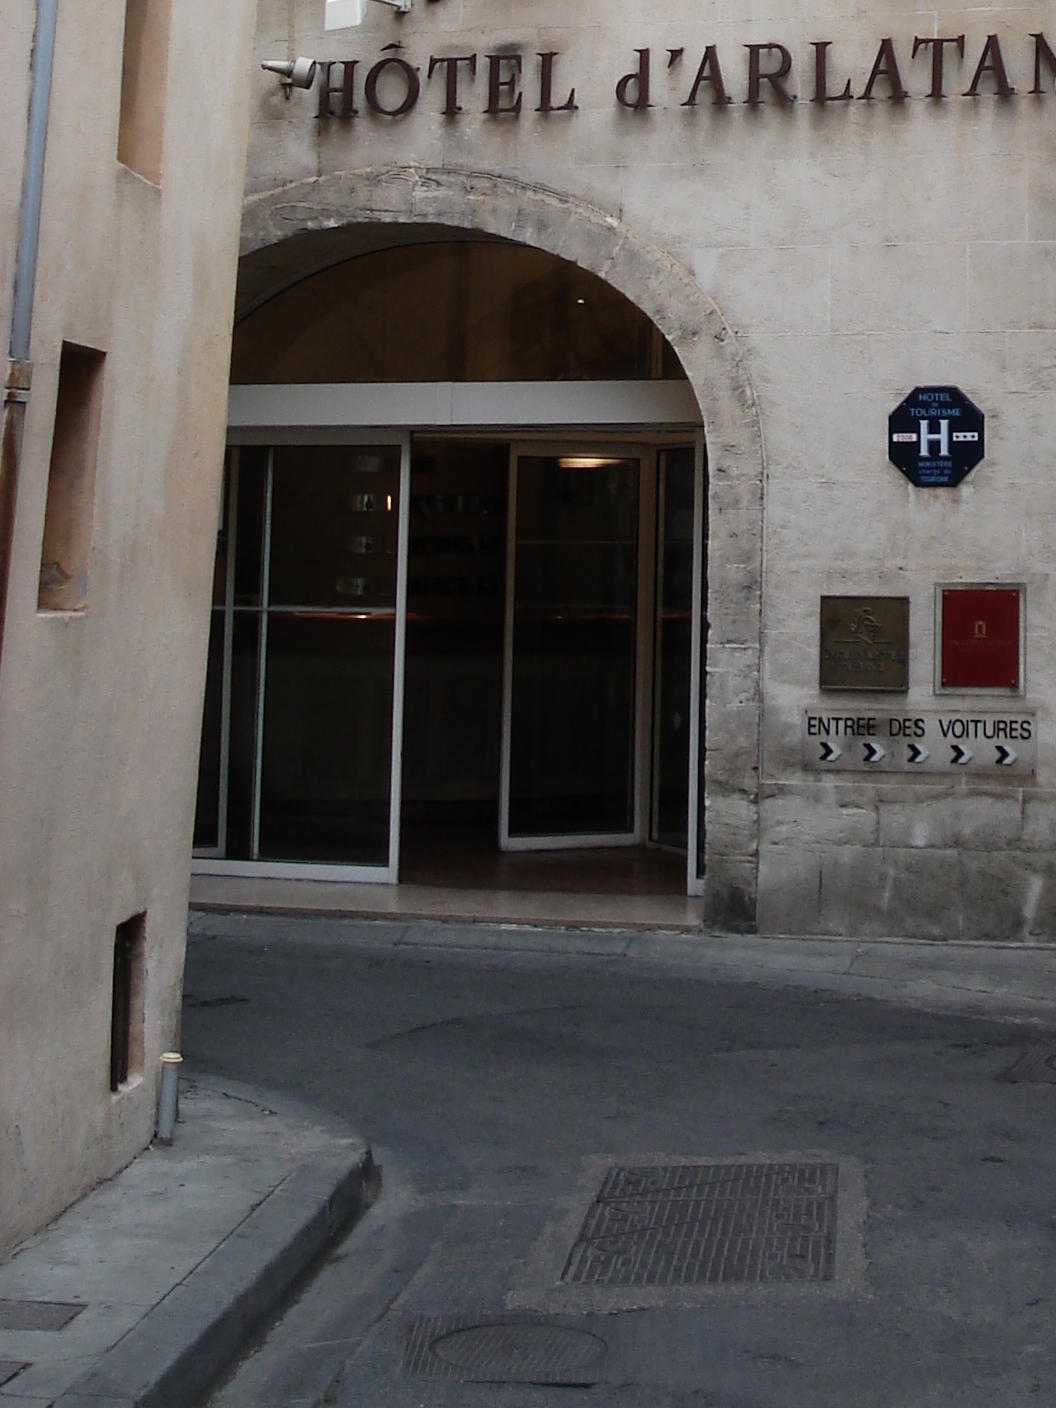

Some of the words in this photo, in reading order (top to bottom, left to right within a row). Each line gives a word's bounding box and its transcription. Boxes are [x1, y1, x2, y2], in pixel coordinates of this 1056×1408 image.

[314, 40, 579, 118] HÔTEL
[919, 393, 952, 401] HOTEL
[910, 408, 961, 416] TOURISME
[919, 419, 951, 457] H
[807, 716, 876, 737] ENTREE
[889, 717, 926, 738] DES
[938, 718, 1032, 740] VOITURES
